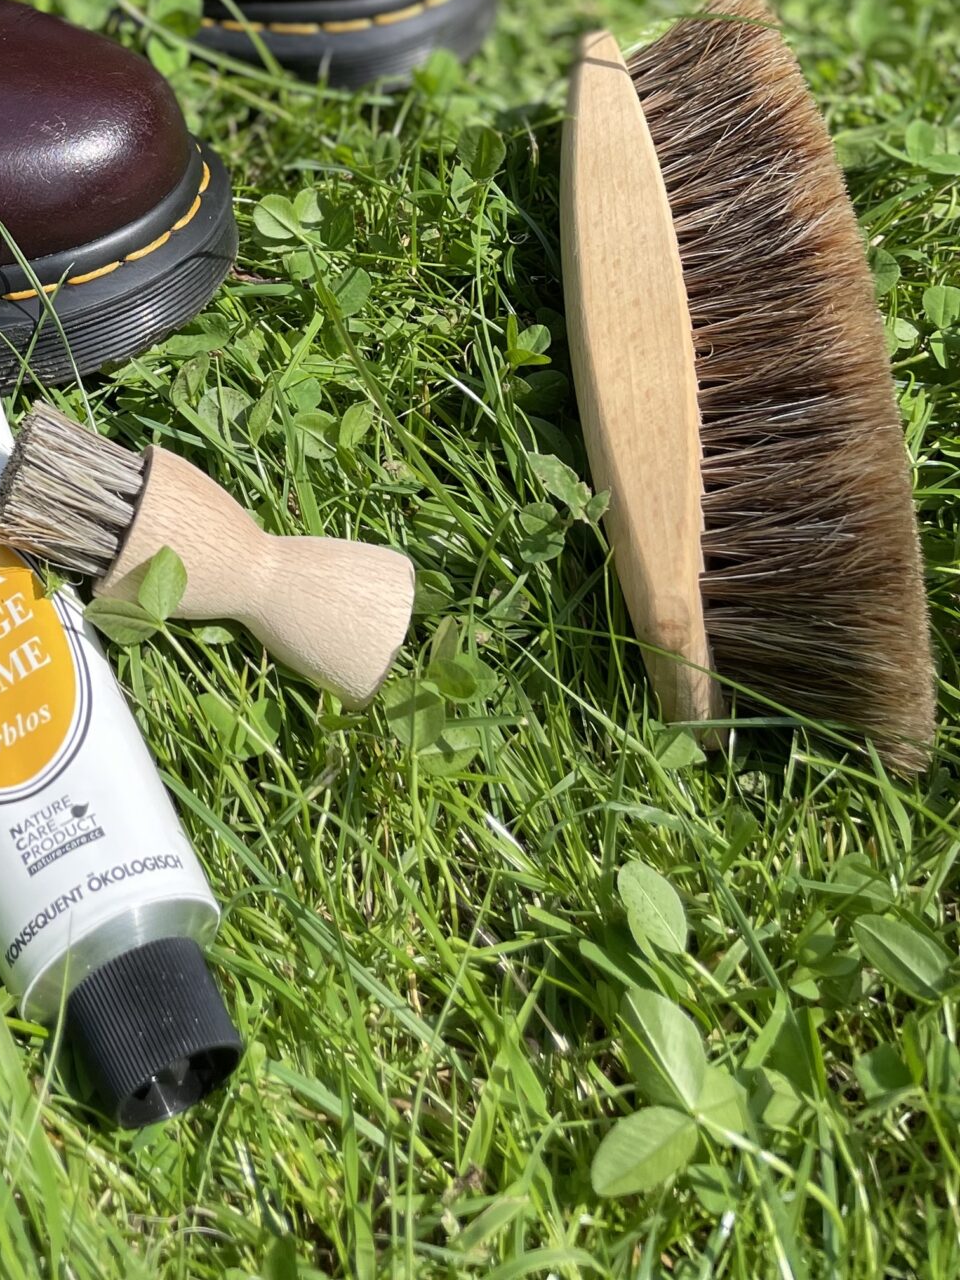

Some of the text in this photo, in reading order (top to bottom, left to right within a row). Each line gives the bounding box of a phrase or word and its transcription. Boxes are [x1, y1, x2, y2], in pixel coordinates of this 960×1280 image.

[9, 794, 74, 840] NATURE
[16, 818, 58, 851] CARE
[21, 813, 97, 866] PRODUCT
[5, 854, 183, 968] KONSEQUENT ÖKOLOGISCH
